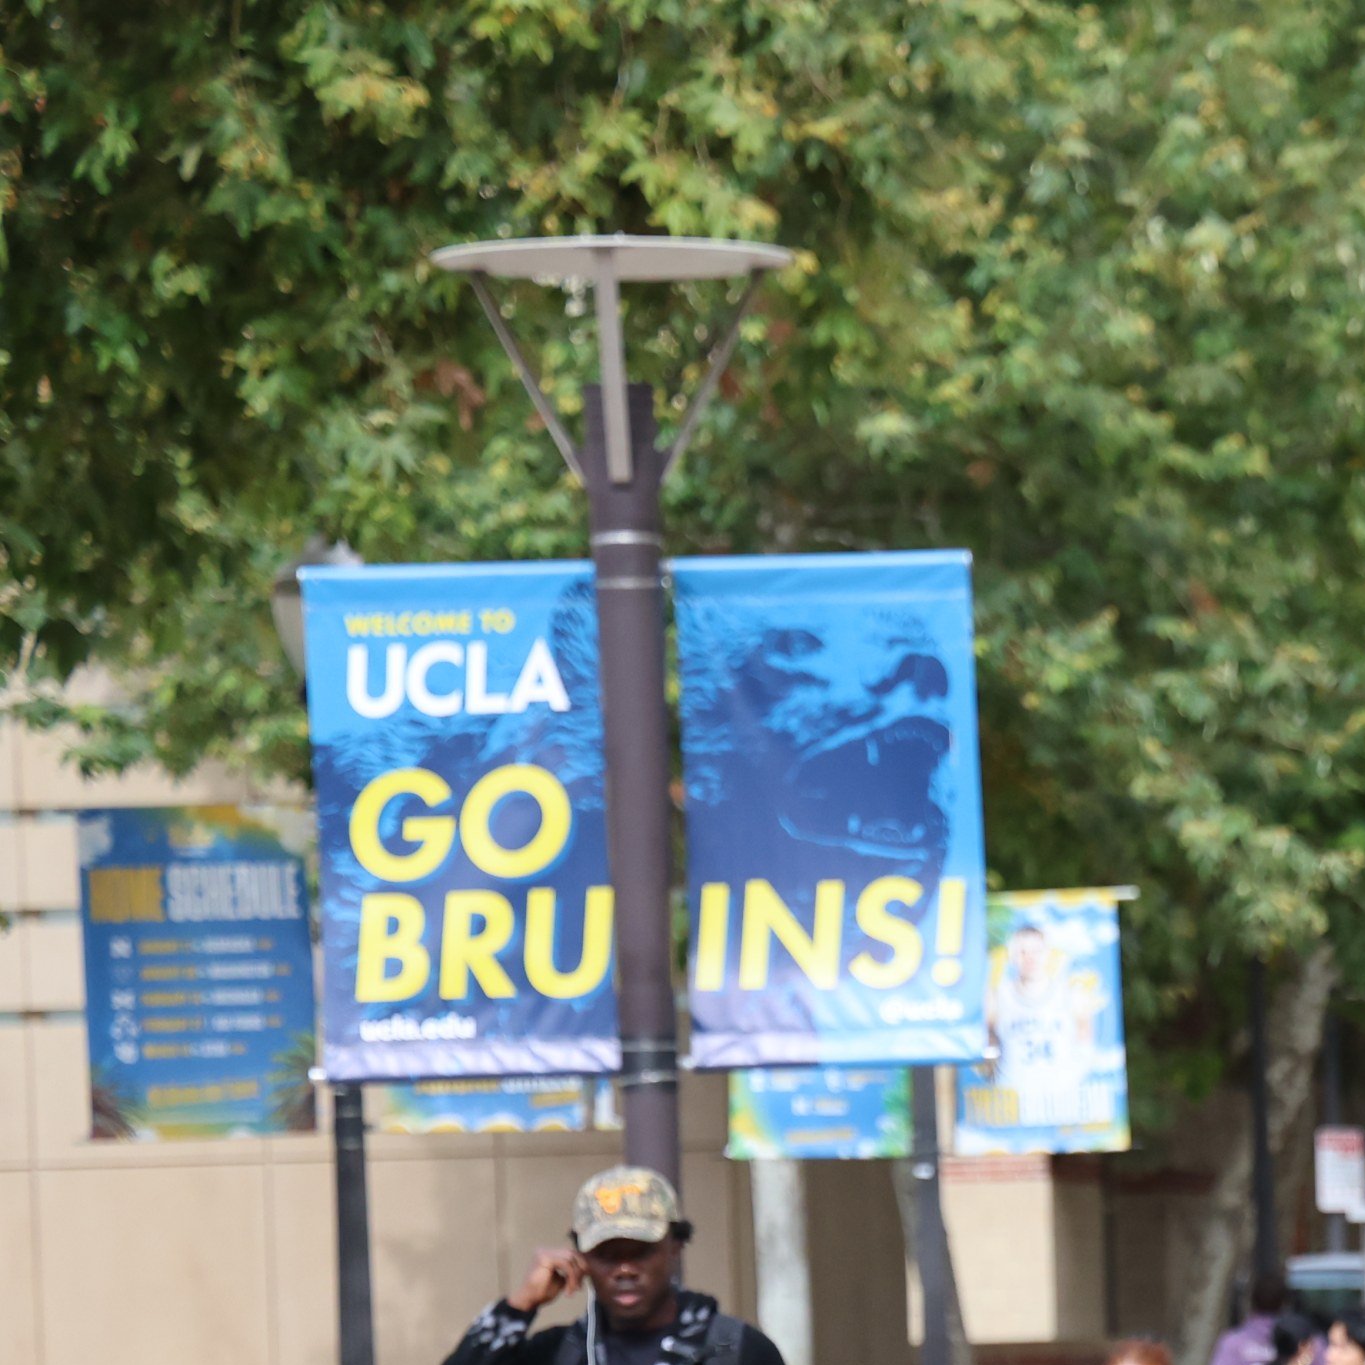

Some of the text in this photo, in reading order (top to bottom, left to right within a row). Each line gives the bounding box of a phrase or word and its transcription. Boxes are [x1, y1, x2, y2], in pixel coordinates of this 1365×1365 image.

[345, 609, 516, 637] WELCOME TO
[346, 638, 571, 719] UCLA
[349, 763, 572, 883] GO
[167, 862, 302, 922] SCHEDULE
[360, 1011, 477, 1042] ucla.edu
[879, 994, 965, 1025] @ucla
